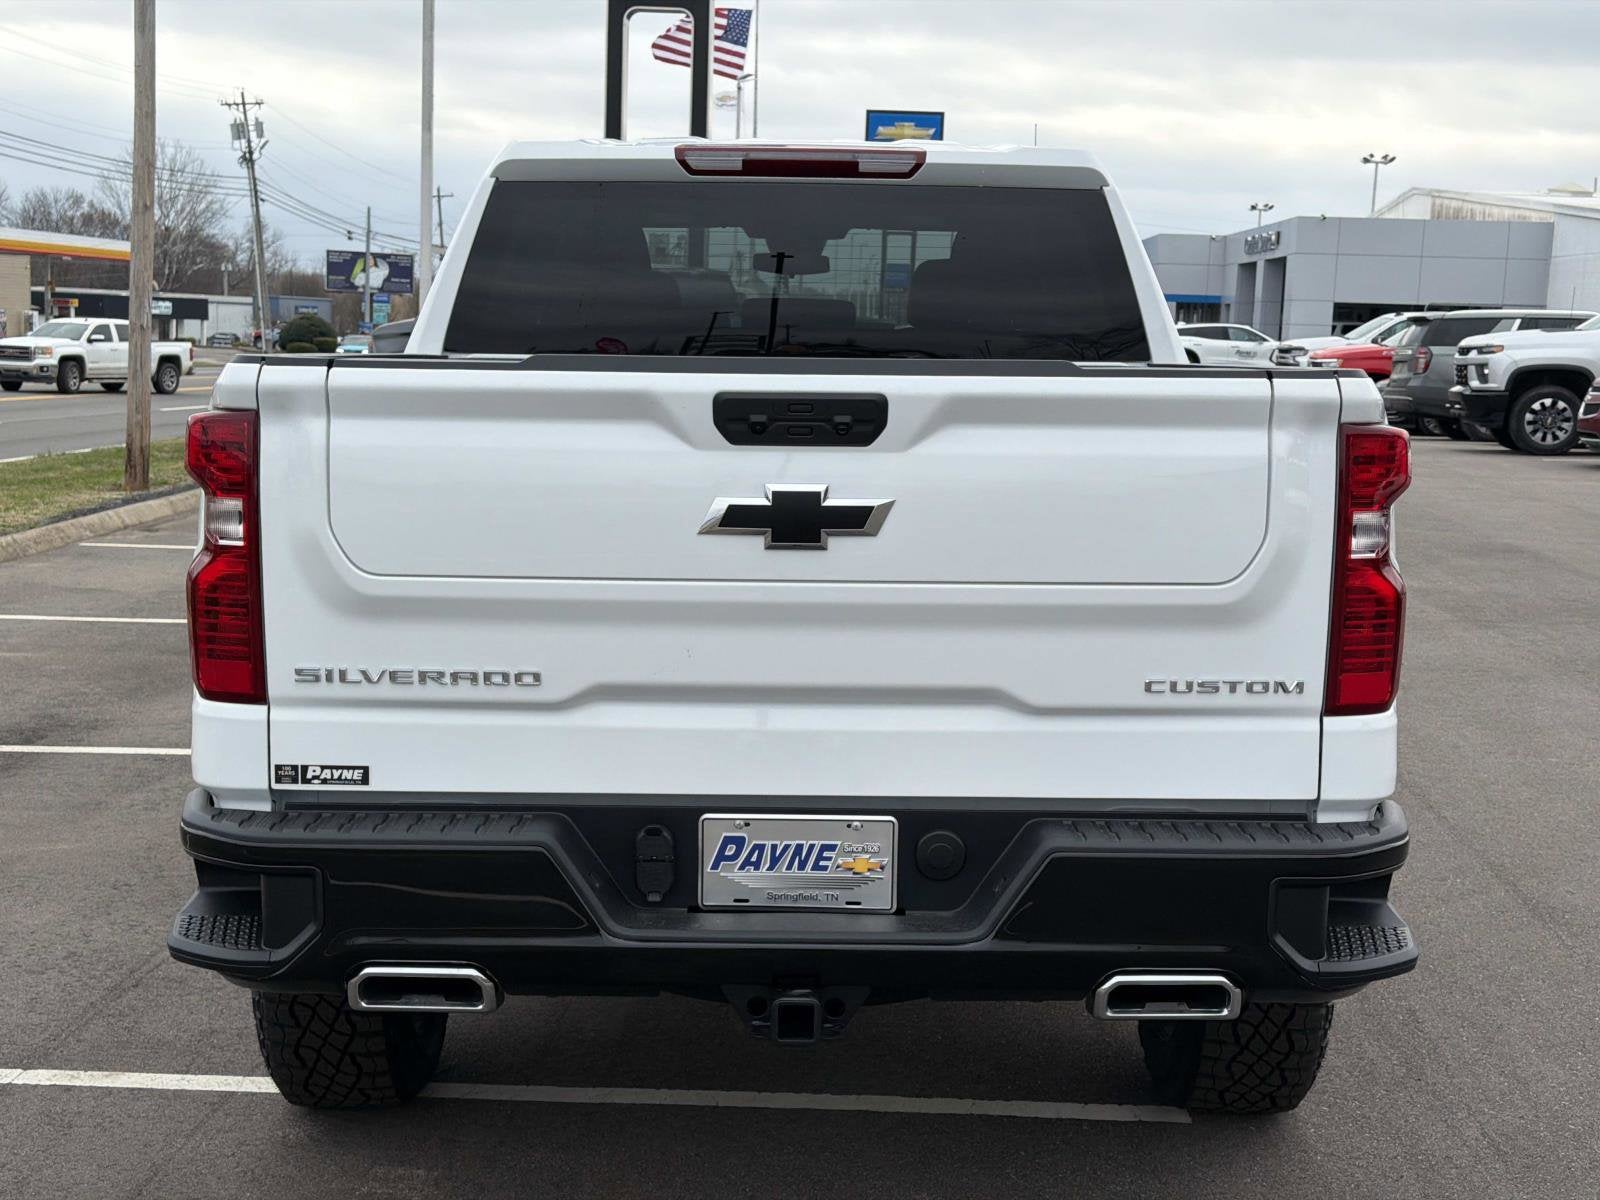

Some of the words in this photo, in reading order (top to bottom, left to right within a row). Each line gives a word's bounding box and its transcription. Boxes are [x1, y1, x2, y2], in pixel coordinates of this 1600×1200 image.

[294, 667, 542, 687] SILVERADO
[1144, 679, 1305, 694] CUSTOM
[306, 766, 364, 780] PAYNE
[707, 832, 842, 873] PAYNE
[843, 843, 863, 853] Since
[864, 842, 880, 853] 1926
[766, 890, 822, 903] Springfield,
[824, 891, 840, 902] TN
